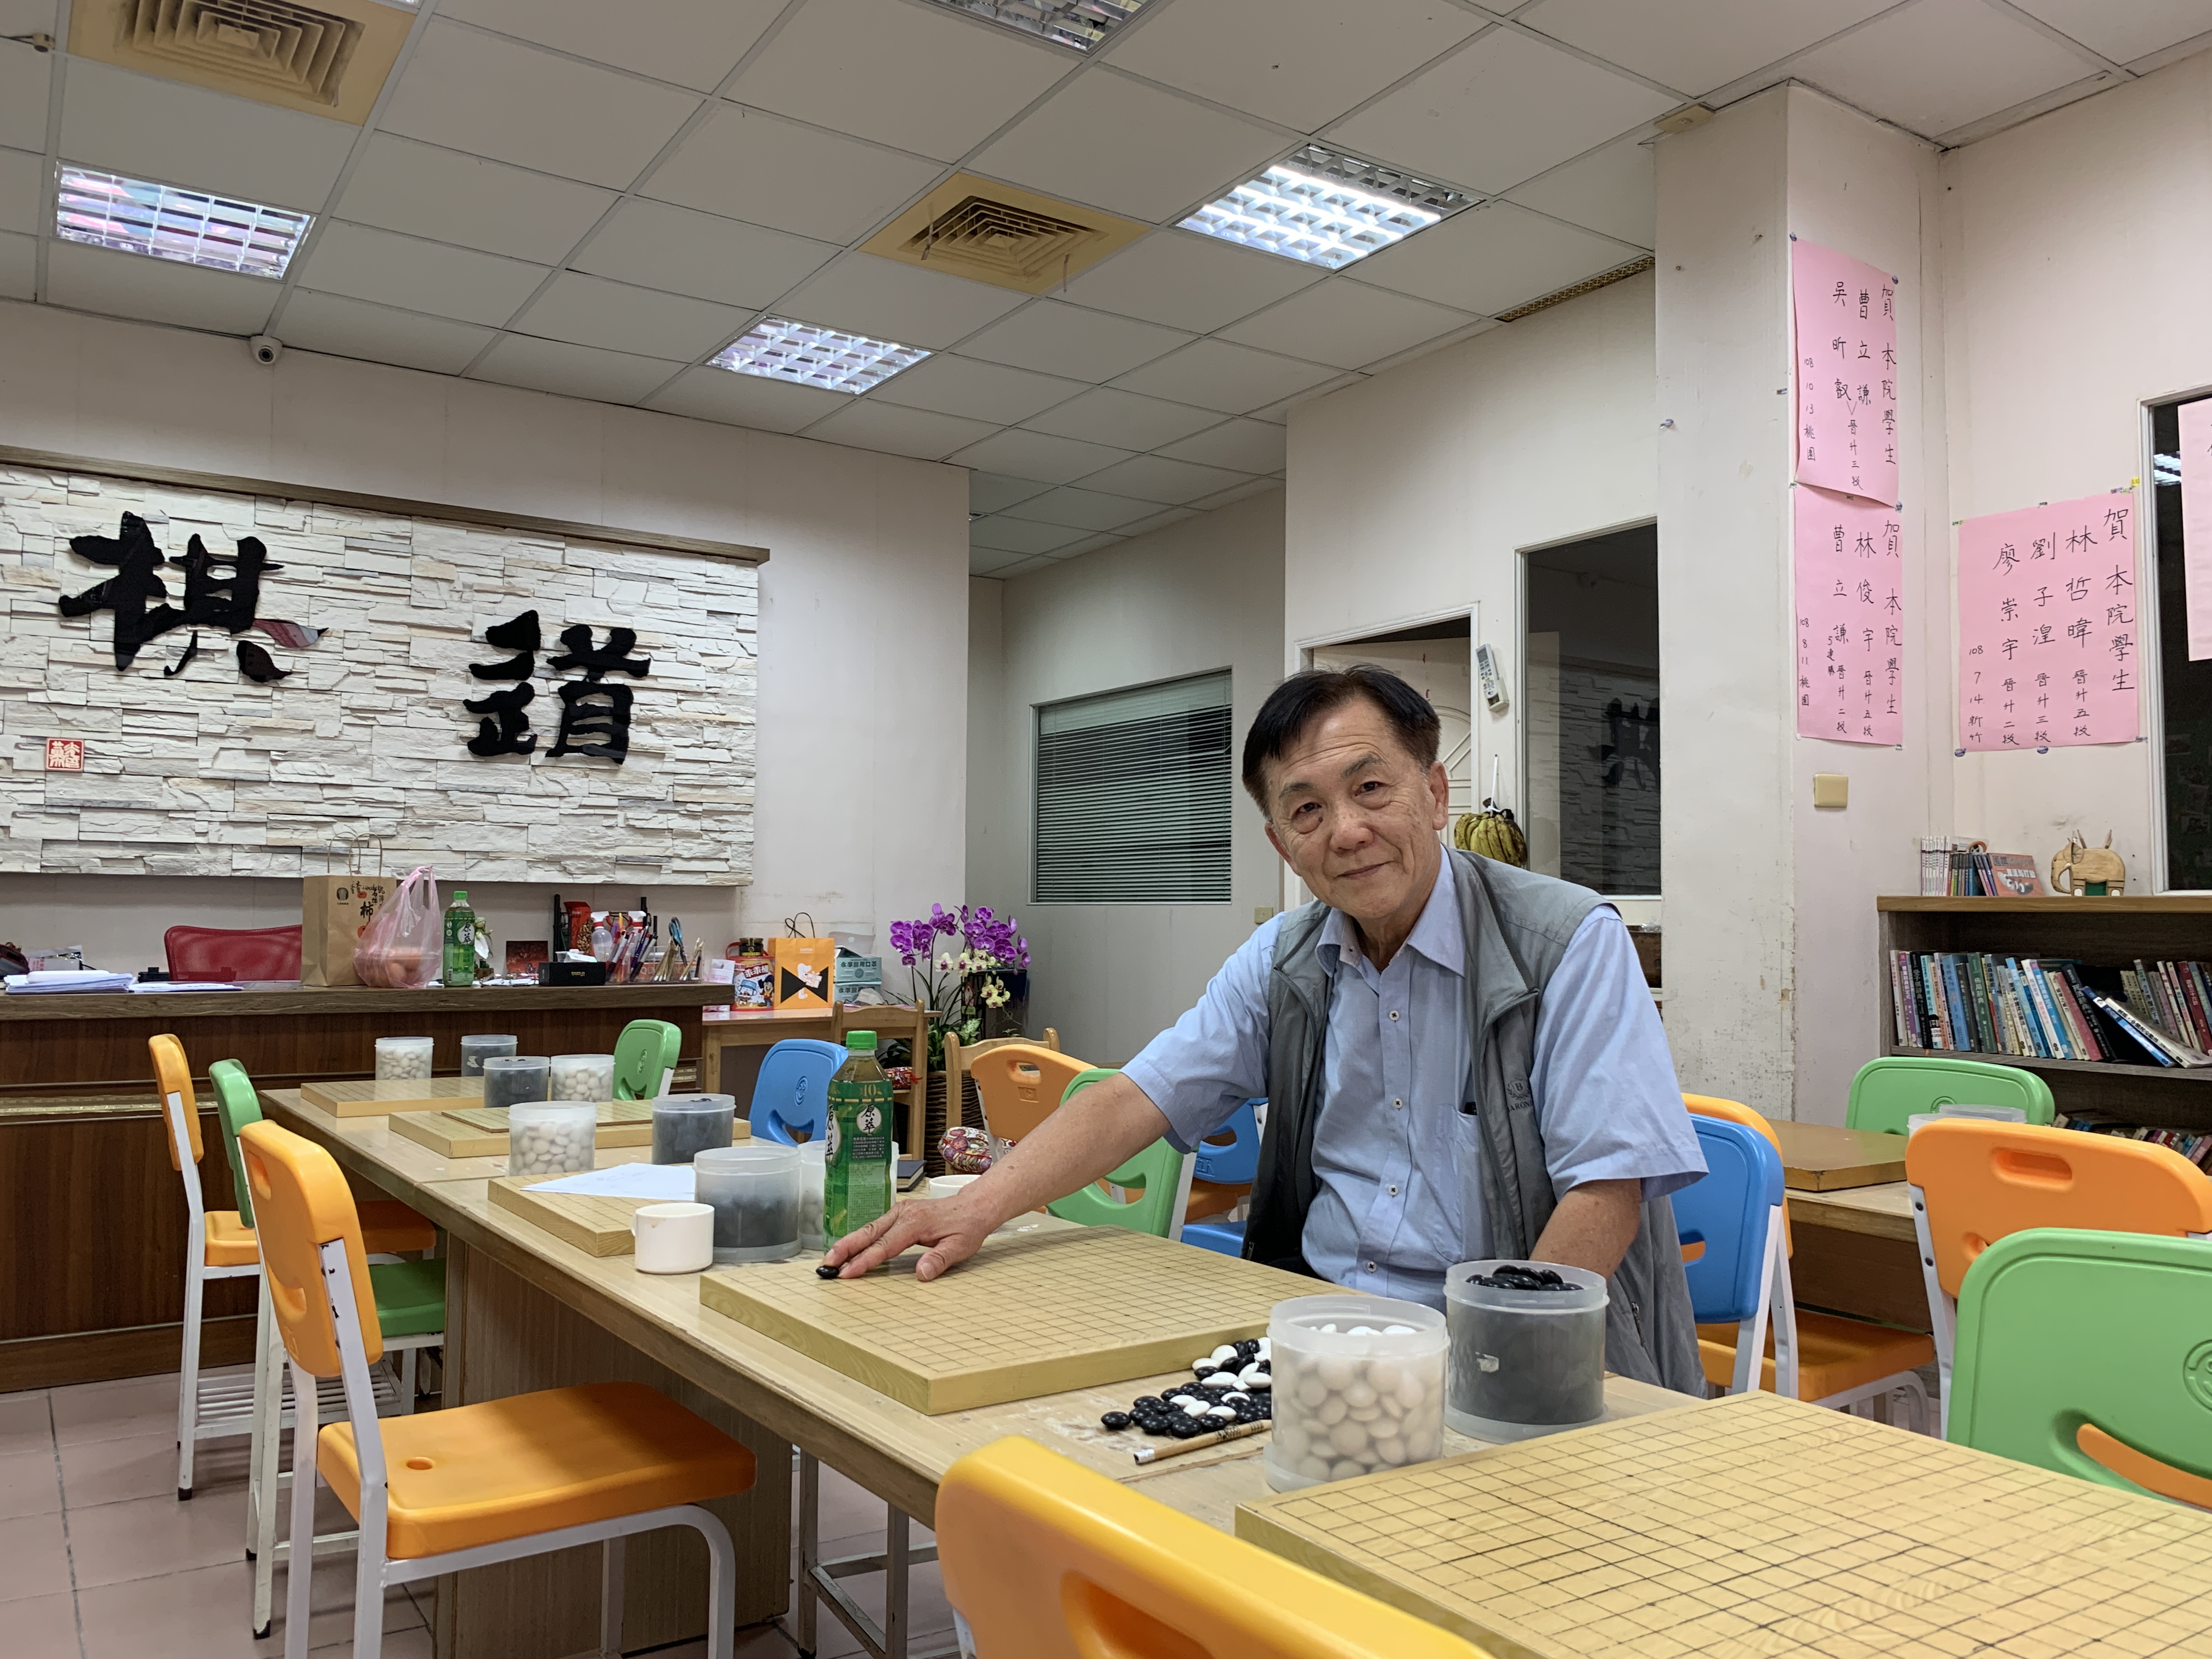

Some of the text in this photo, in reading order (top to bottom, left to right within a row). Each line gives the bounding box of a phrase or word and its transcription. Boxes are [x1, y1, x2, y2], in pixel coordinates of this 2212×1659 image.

[1883, 520, 1902, 714] 賀本院學生
[2104, 509, 2134, 691] 賀本院學生
[861, 1104, 876, 1133] 原萃
